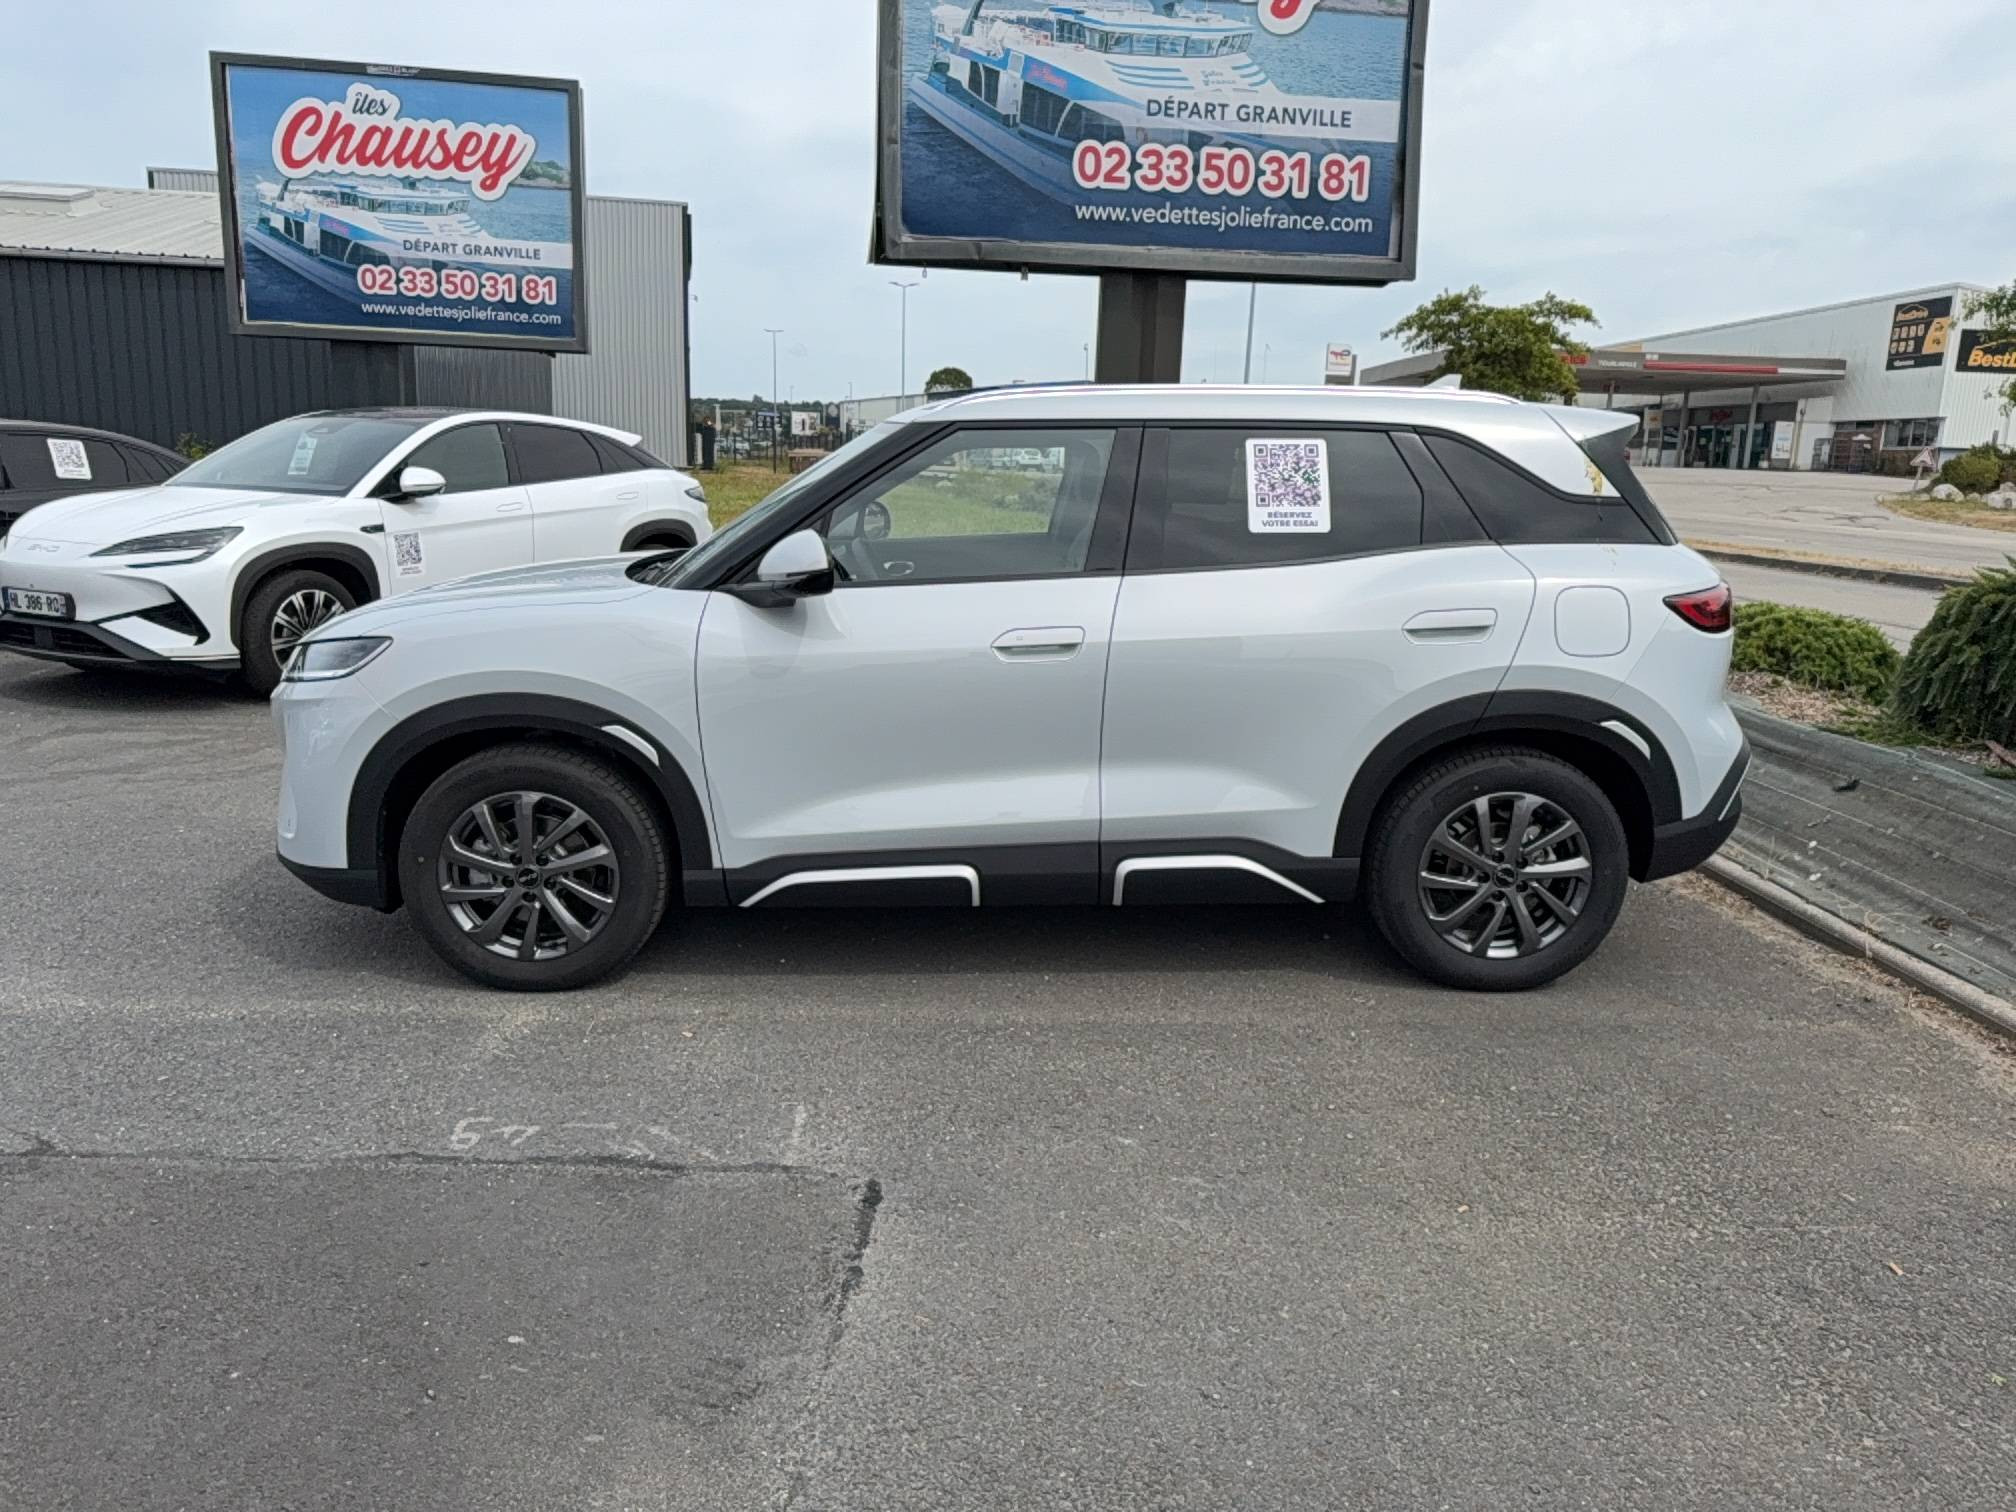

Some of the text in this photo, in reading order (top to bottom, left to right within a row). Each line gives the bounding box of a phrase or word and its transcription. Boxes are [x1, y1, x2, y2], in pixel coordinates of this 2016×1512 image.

[351, 91, 391, 117] îles
[1146, 95, 1353, 129] DÉPART GRANVILLE
[280, 105, 528, 193] Chausey
[1076, 144, 1366, 197] 02 33 50 31 81
[1074, 202, 1374, 233] www.vedettesjoliefrance.com
[402, 238, 542, 261] DÉPART GRANVILLE
[360, 266, 555, 302] 02 33 50 31 81
[361, 302, 562, 325] www.vedettesjoliefrance.com
